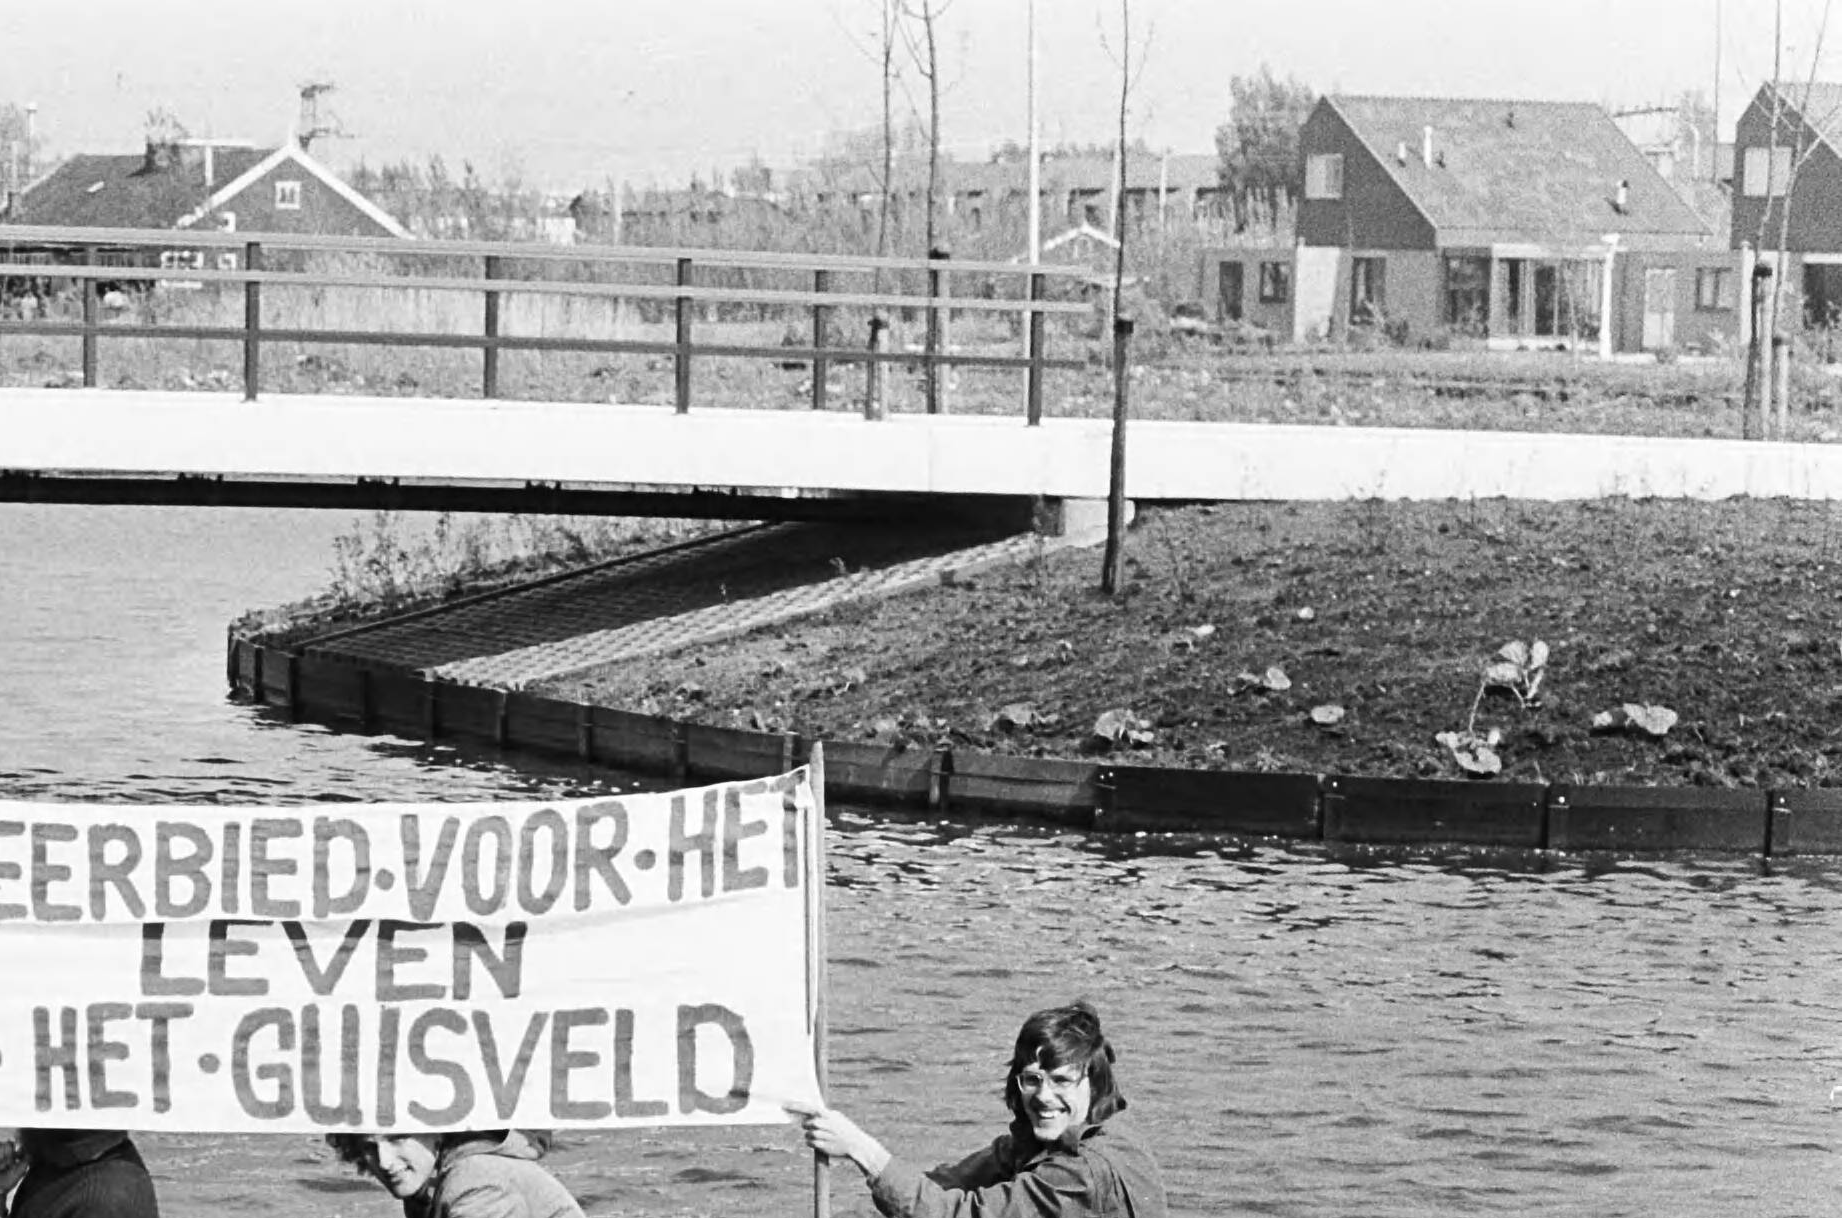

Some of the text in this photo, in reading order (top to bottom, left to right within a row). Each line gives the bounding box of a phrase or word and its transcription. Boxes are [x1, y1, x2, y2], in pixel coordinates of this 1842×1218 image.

[399, 801, 633, 921] VOOR
[667, 768, 807, 902] HET
[140, 920, 528, 1002] LEVEN
[32, 1002, 195, 1114] HET
[231, 1002, 755, 1127] GUISVELD
